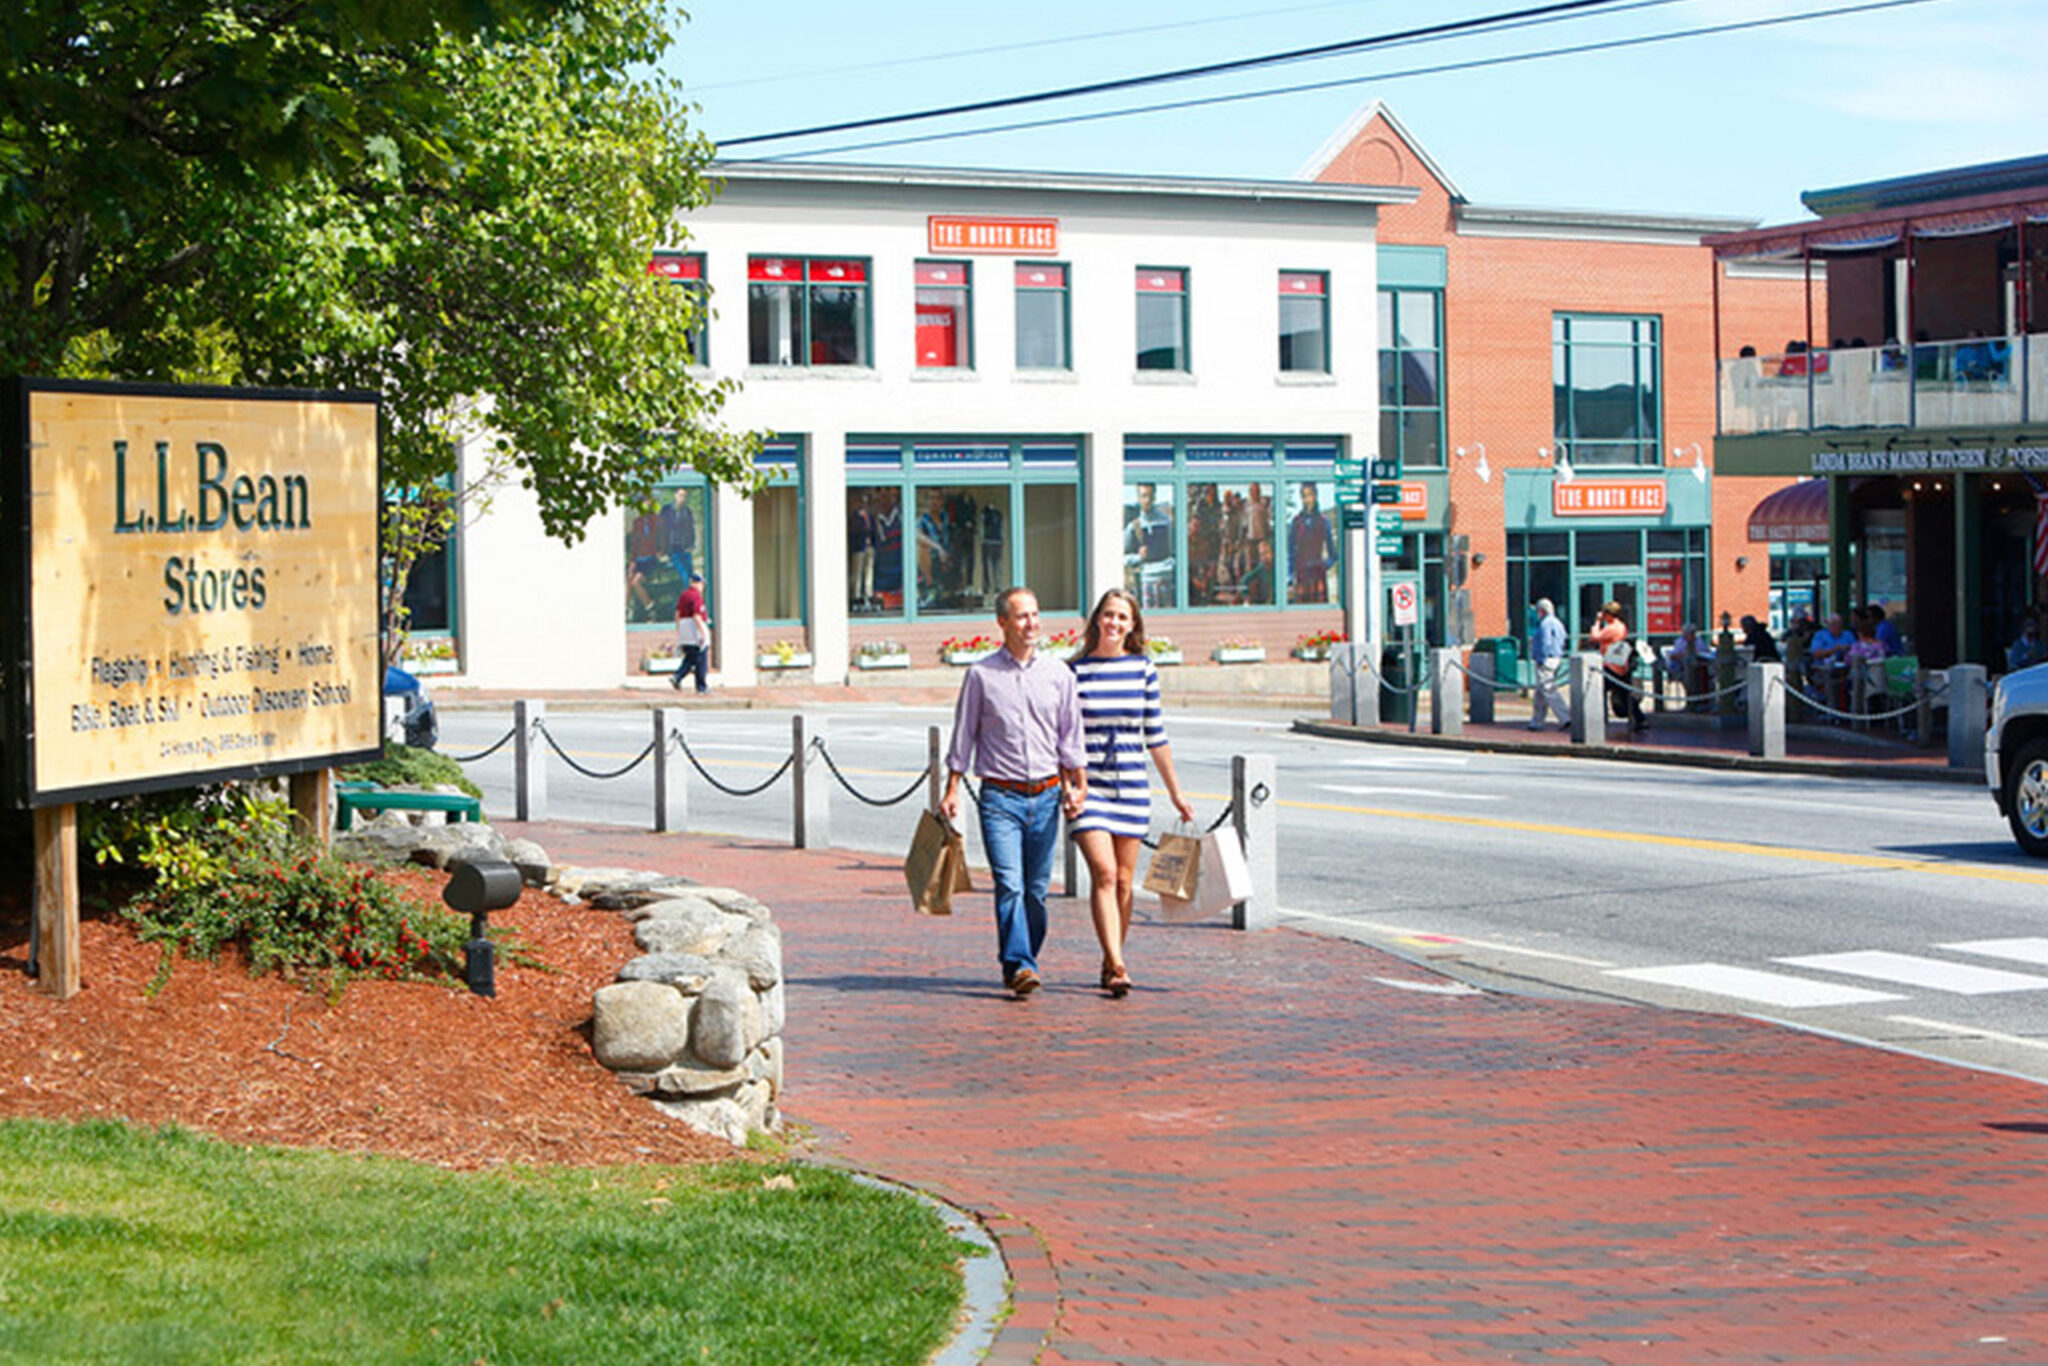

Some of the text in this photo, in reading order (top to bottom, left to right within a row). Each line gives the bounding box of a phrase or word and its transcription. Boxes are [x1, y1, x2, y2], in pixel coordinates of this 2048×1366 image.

[937, 225, 1052, 246] THE NORTH FACE
[114, 440, 311, 534] L.L.Bean
[1561, 488, 1660, 507] THE NORTH FACE
[163, 556, 267, 615] Stores
[222, 647, 232, 672] &
[236, 646, 279, 675] Fishing
[298, 643, 333, 666] Home
[144, 697, 156, 724] &
[312, 680, 352, 706] School
